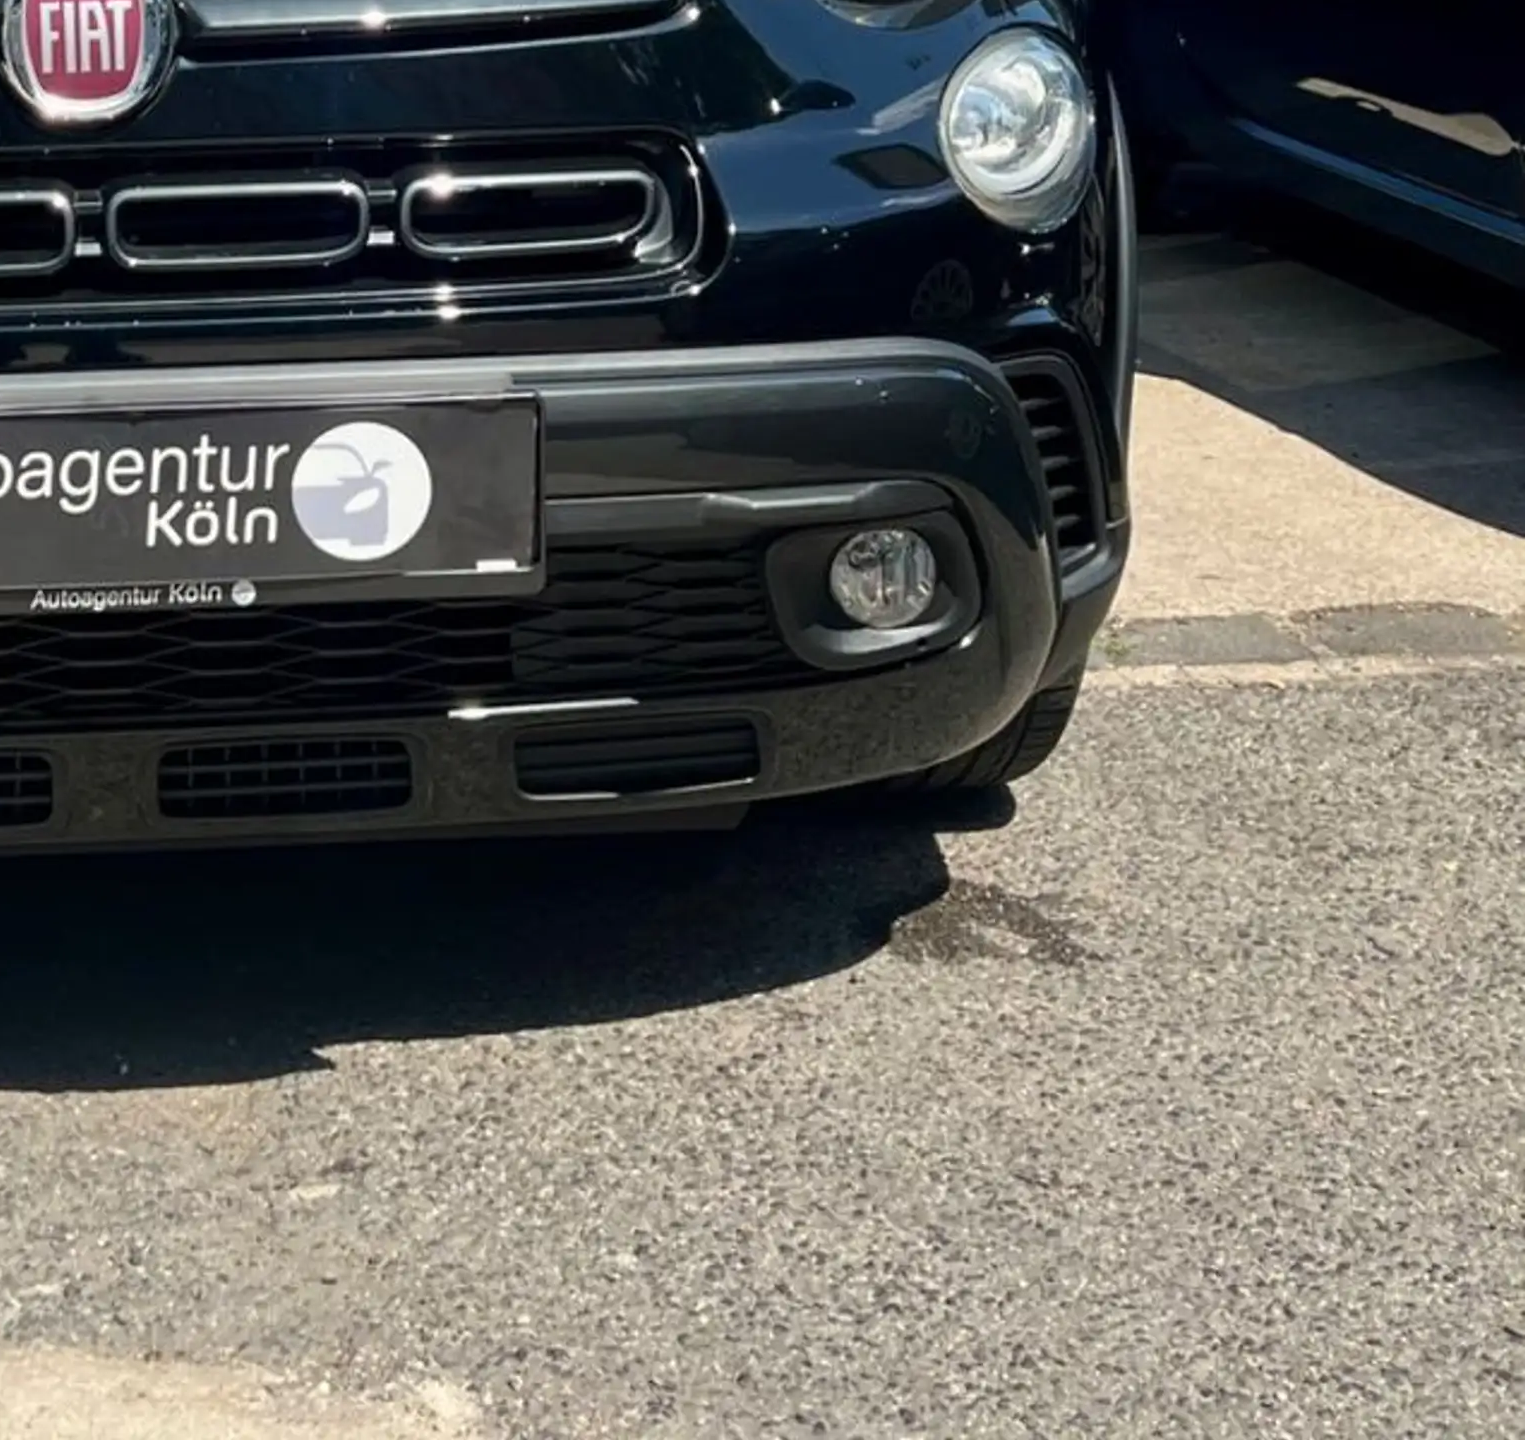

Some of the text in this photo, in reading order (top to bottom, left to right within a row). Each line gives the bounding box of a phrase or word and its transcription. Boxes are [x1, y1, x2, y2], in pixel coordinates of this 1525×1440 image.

[145, 497, 278, 549] Köln
[29, 581, 224, 612] Autoagentur Köln
